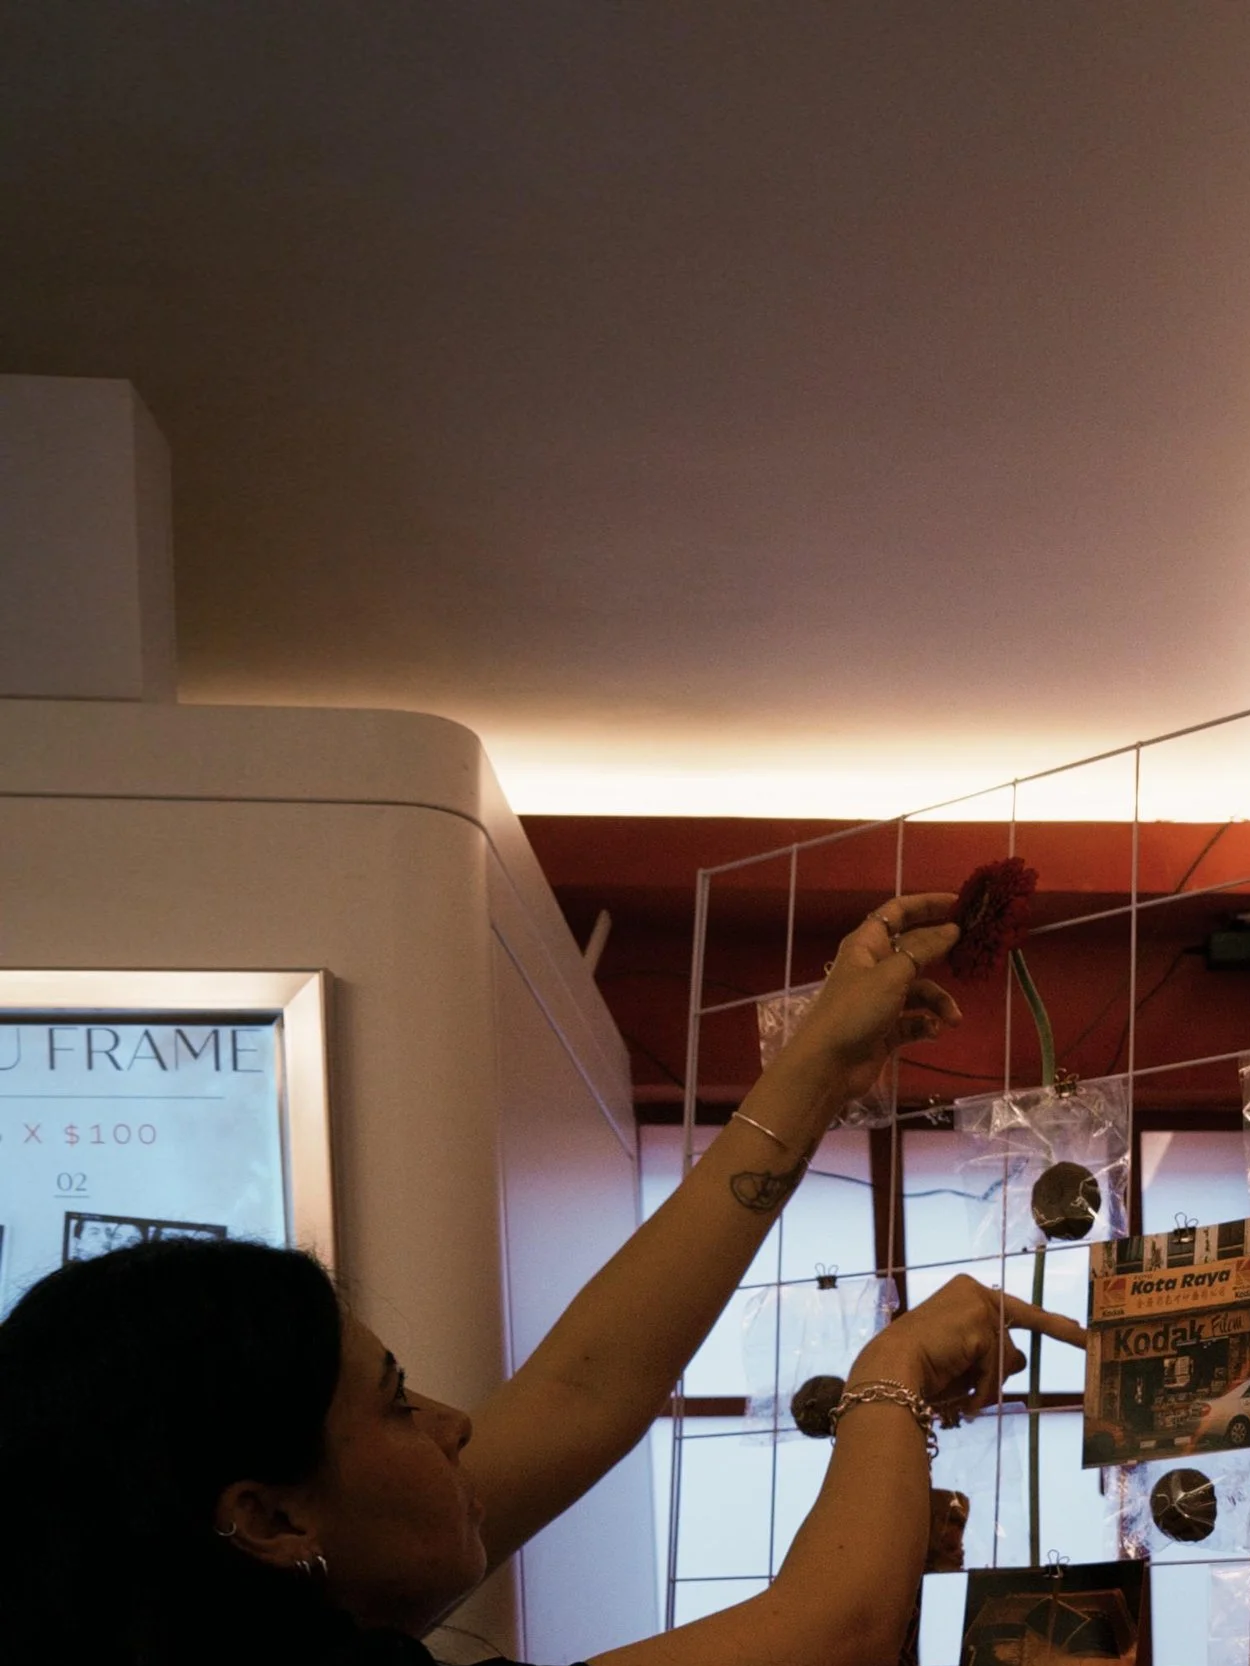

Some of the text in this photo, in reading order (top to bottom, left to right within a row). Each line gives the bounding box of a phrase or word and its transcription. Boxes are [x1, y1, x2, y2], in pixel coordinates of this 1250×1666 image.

[48, 1027, 264, 1073] FRAME
[23, 1123, 43, 1144] X
[64, 1121, 157, 1147] $100
[56, 1172, 88, 1192] 02
[1130, 1269, 1231, 1296] Kota Raya
[1112, 1318, 1205, 1359] Kodak
